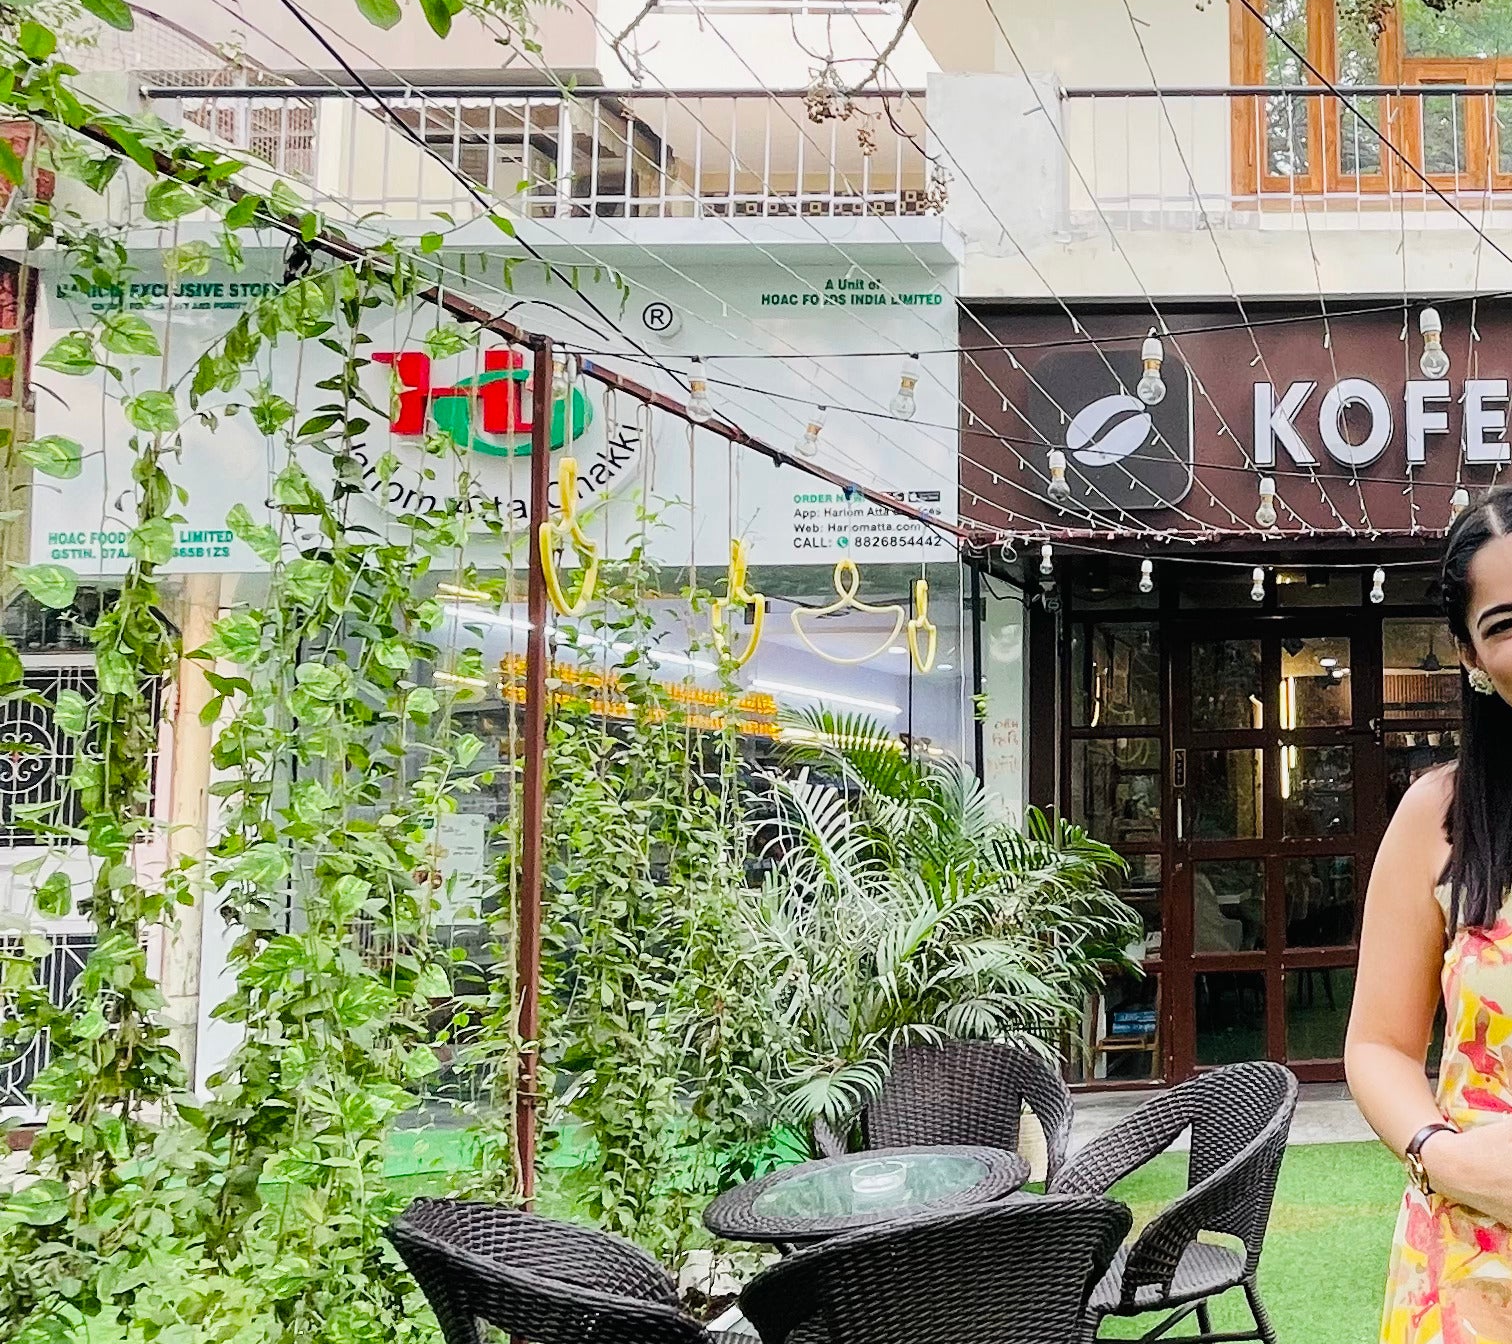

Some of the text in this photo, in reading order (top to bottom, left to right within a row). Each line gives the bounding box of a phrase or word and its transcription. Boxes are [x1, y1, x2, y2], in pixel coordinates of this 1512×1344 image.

[825, 279, 834, 290] A
[838, 279, 864, 290] Unit
[761, 294, 798, 306] HOAC
[850, 294, 886, 305] INDIA
[793, 494, 832, 504] ORDER
[827, 522, 921, 533] Haromatta.com
[89, 531, 128, 545] FOOD
[179, 529, 234, 544] LIMITED
[854, 536, 942, 548] 8826854442
